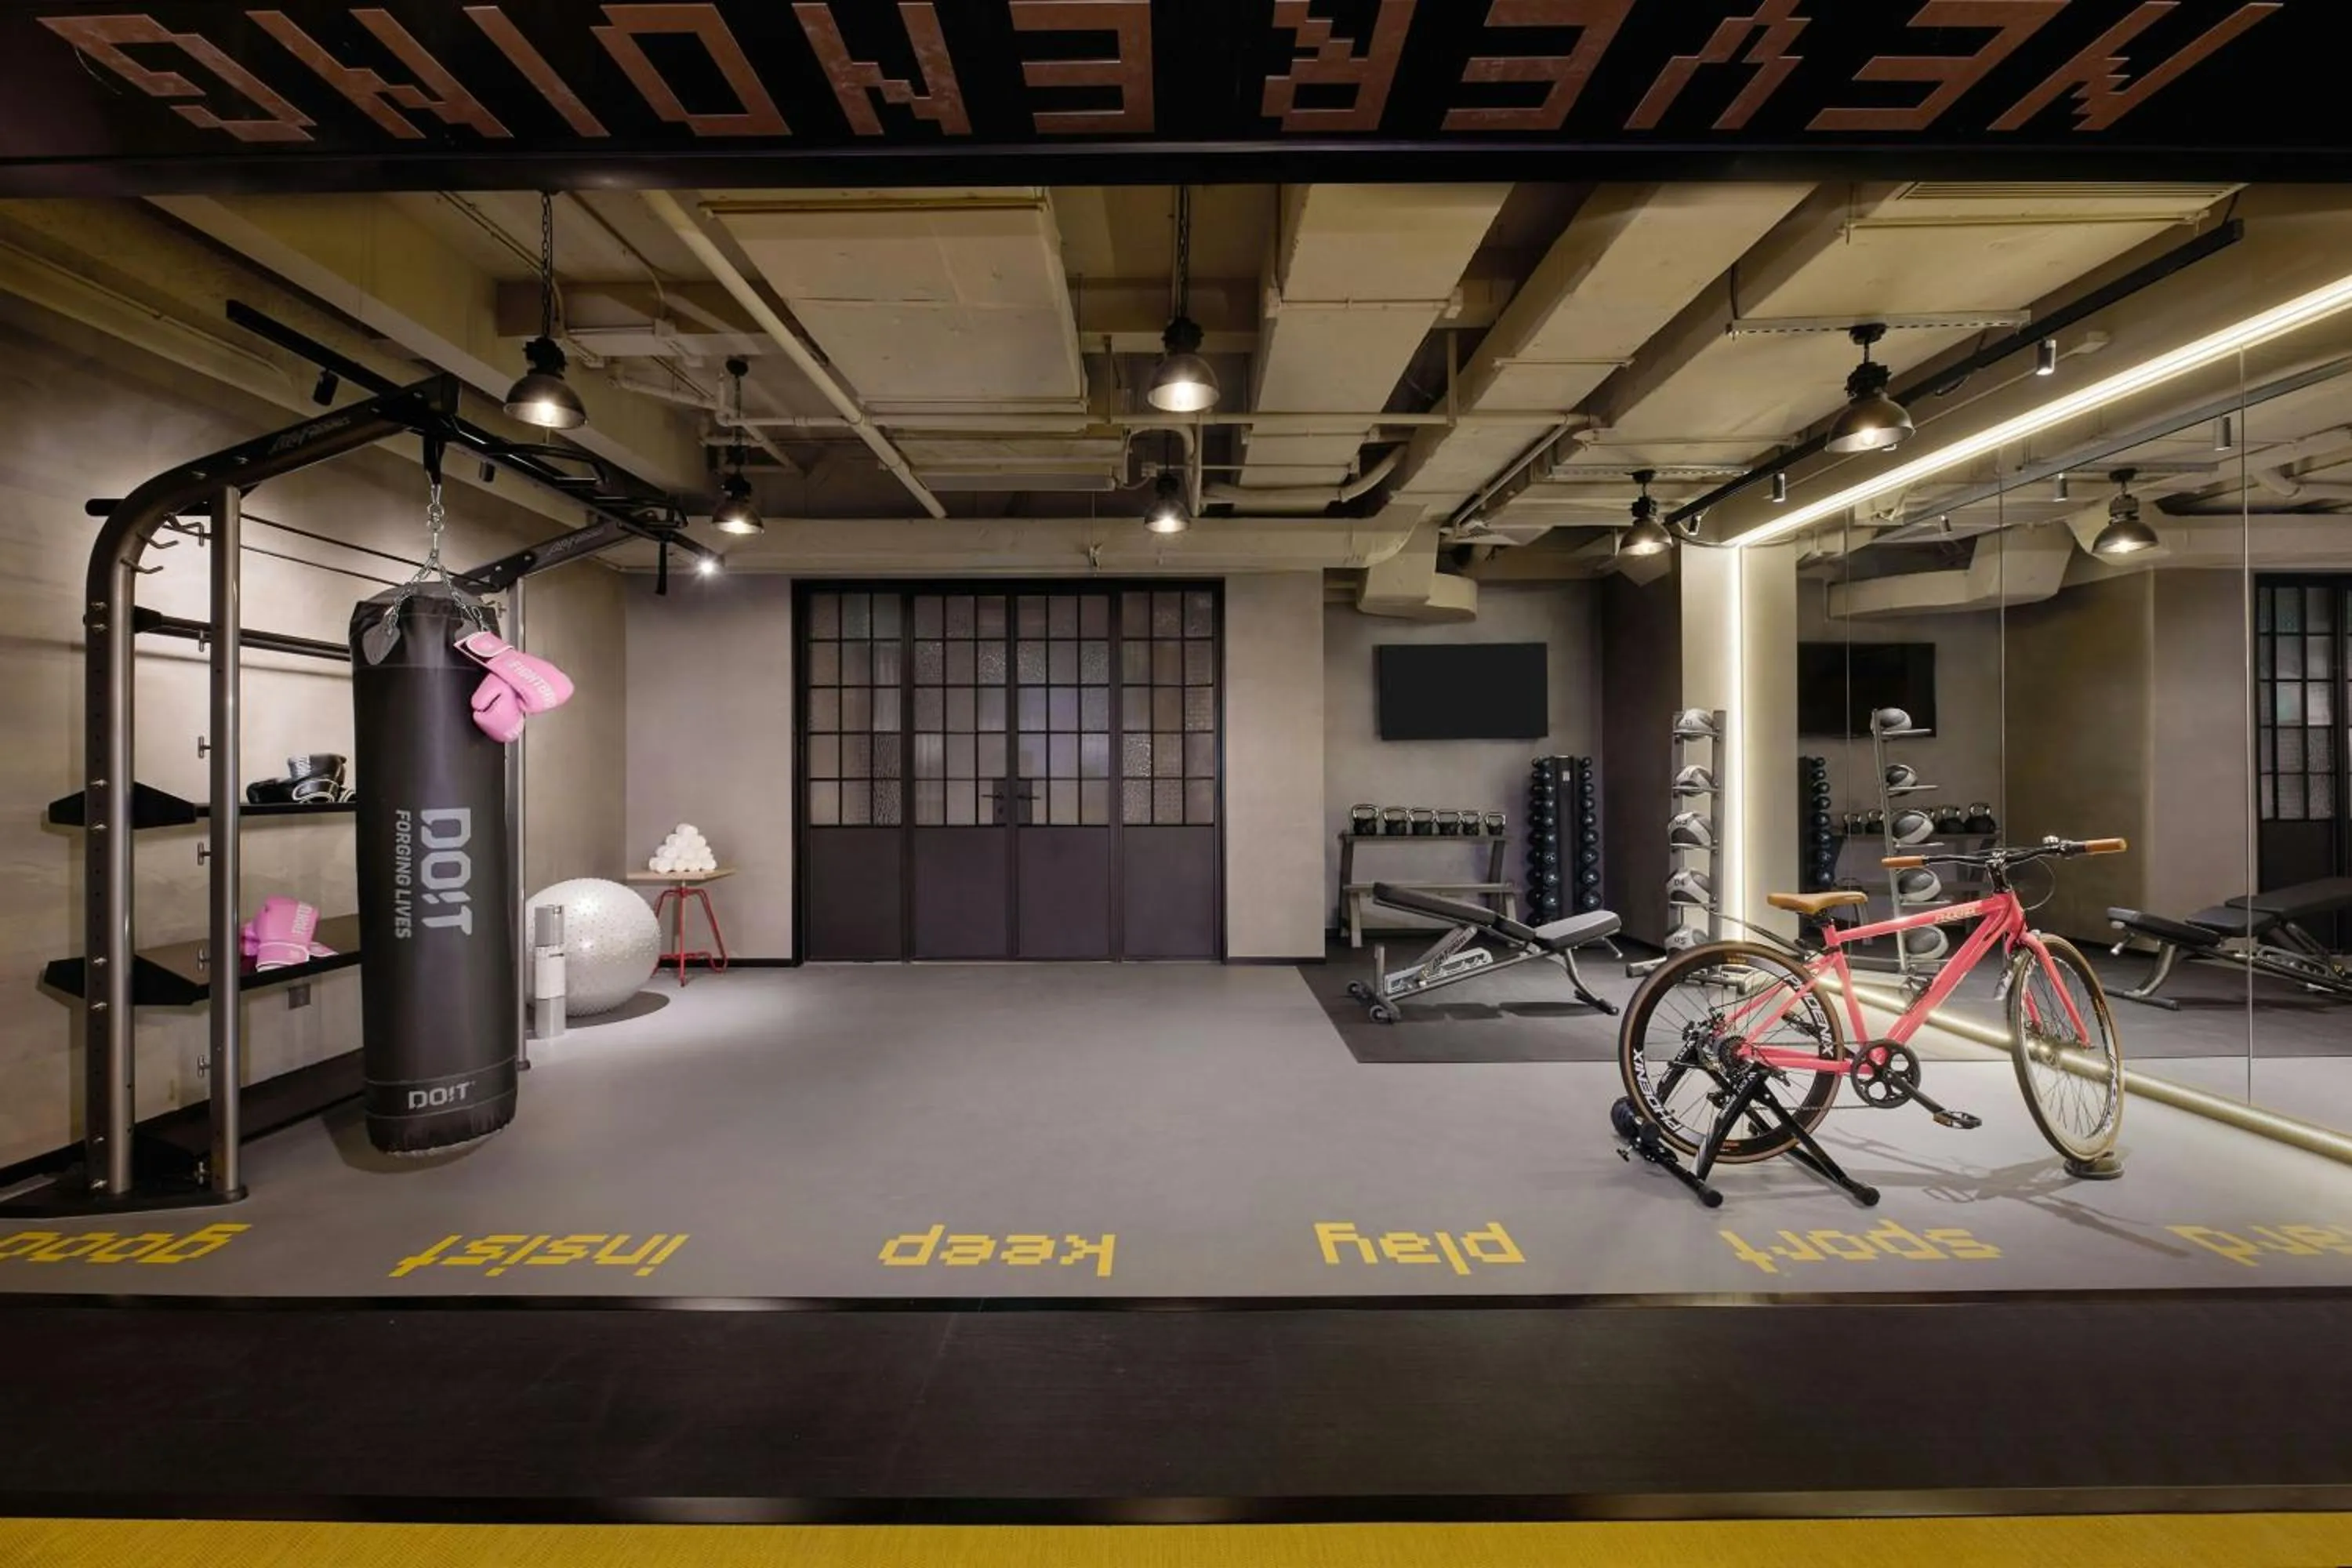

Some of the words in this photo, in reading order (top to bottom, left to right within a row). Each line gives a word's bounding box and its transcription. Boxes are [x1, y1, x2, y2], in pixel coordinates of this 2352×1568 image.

[37, 0, 1152, 142] ENDING
[1263, 0, 2283, 131] NEVER
[395, 809, 412, 886] FORGING
[394, 888, 412, 939] LIVES
[389, 1234, 690, 1276] insist
[878, 1224, 1116, 1277] keep
[1313, 1221, 1526, 1276] play
[1718, 1218, 2005, 1273] sport
[2165, 1225, 2352, 1267] ard
